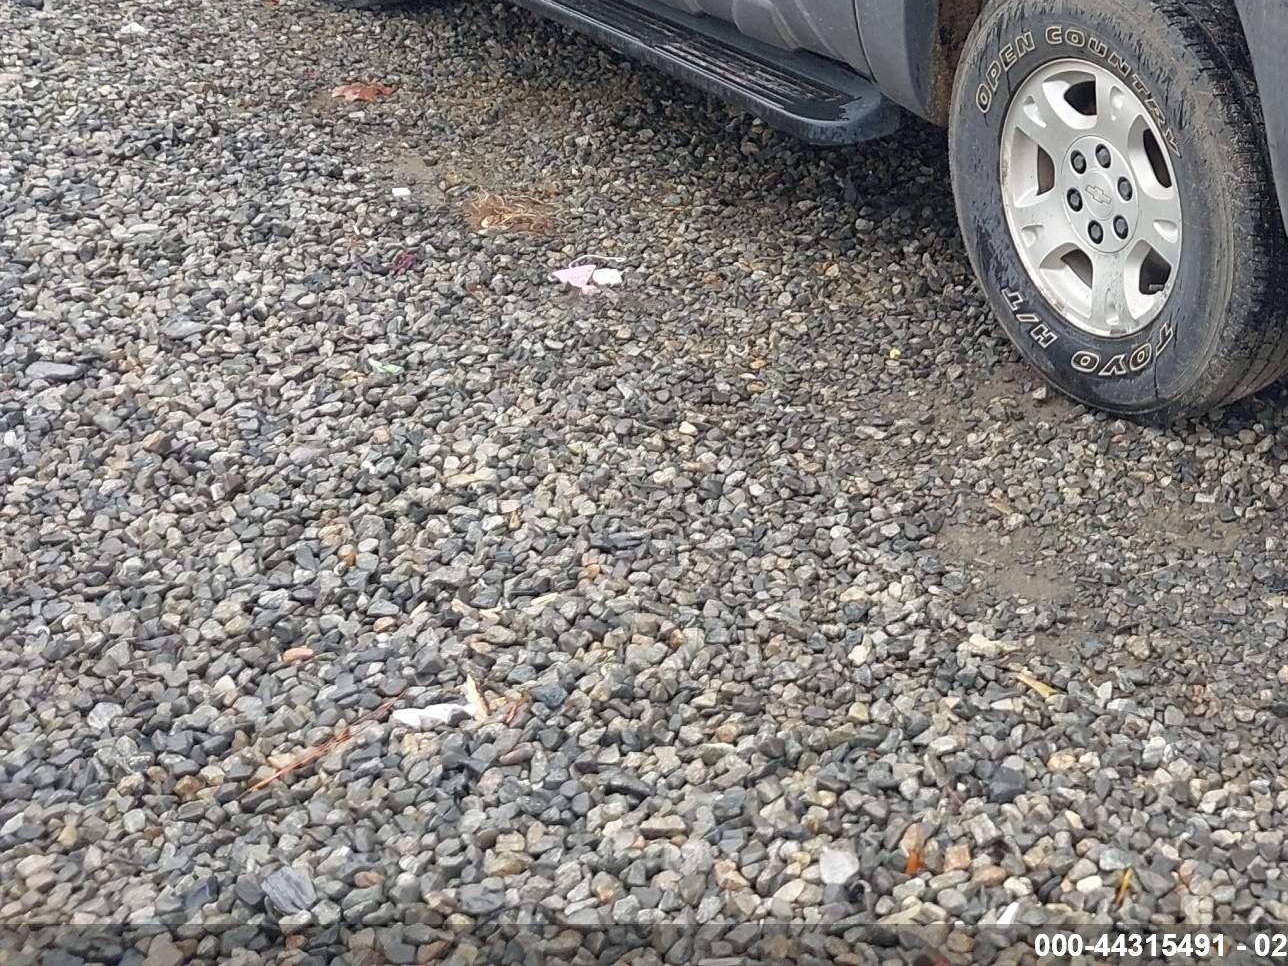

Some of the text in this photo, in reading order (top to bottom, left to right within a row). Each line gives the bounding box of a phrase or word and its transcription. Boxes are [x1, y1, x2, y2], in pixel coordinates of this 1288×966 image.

[975, 25, 1181, 159] OPEN COUNTRY
[1071, 322, 1174, 377] TOYO
